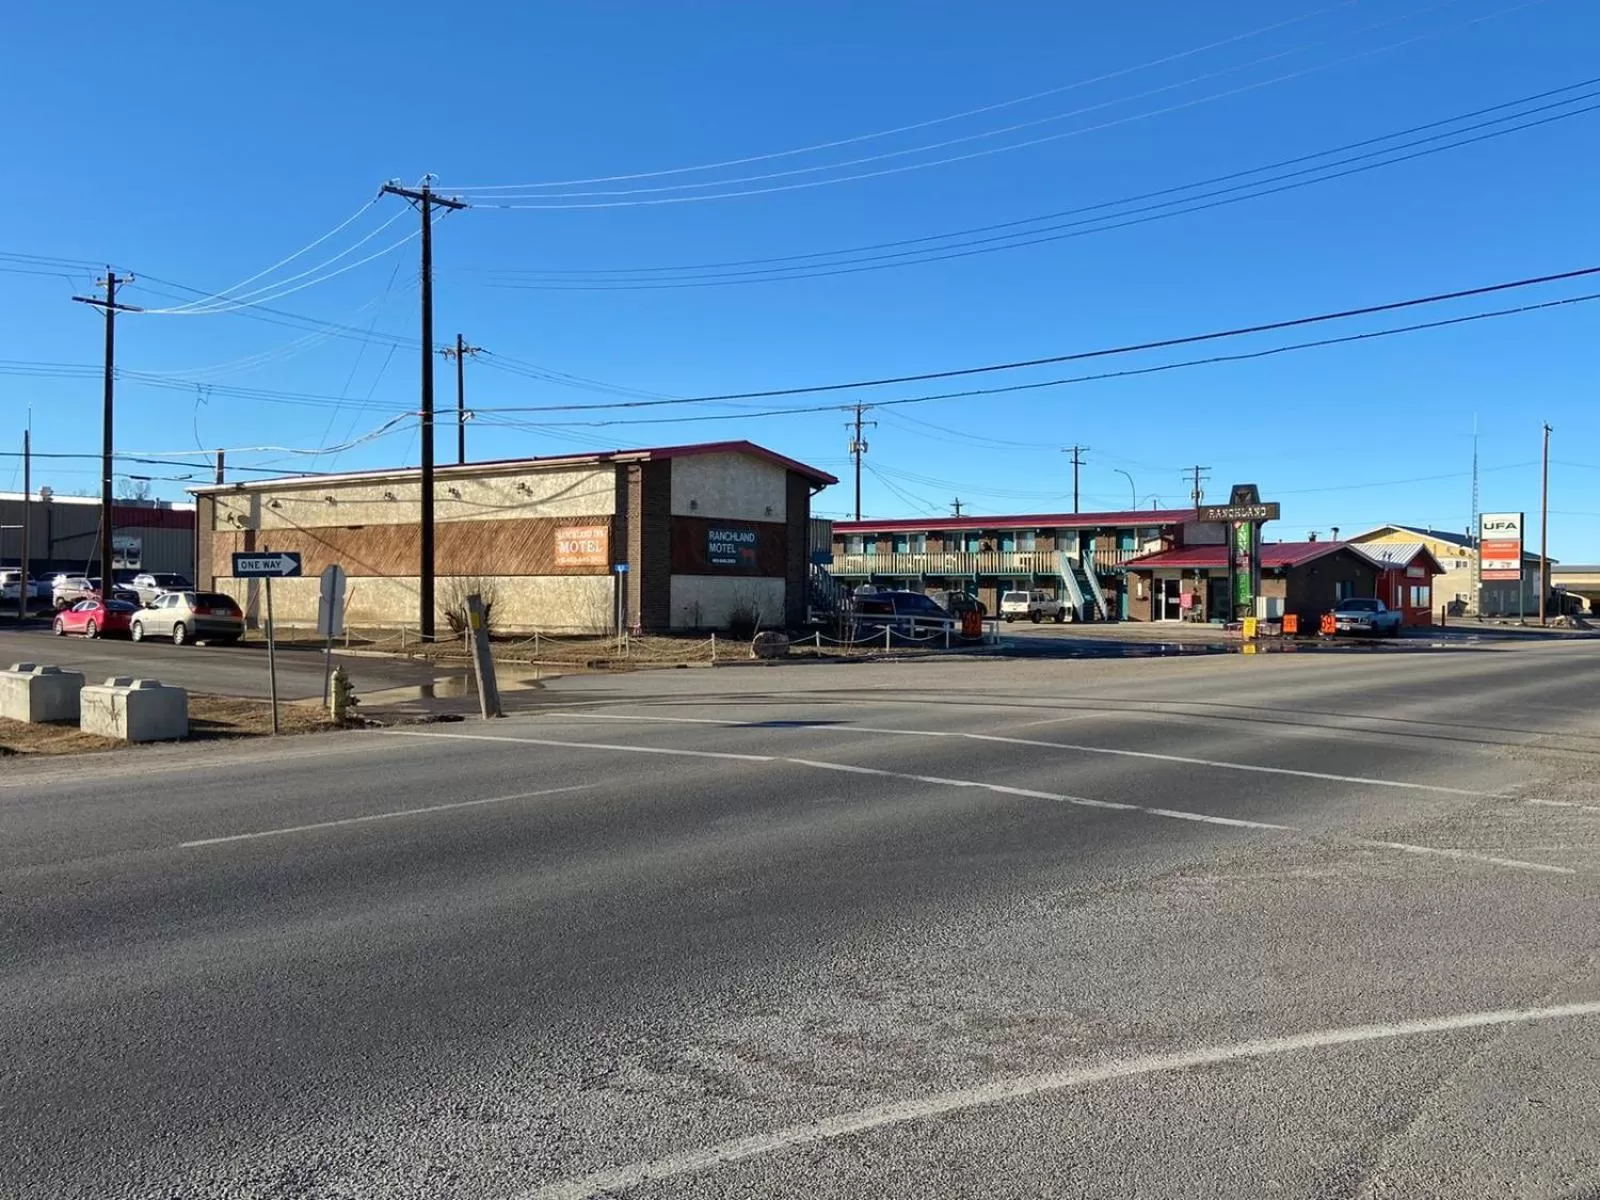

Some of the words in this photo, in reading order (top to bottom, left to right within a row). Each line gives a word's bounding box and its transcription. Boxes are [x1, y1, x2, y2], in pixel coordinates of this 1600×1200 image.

[1484, 522, 1517, 530] UFA
[709, 530, 755, 543] RANCHLAND
[557, 540, 603, 553] MOTEL
[709, 543, 736, 554] MOTEL
[241, 561, 259, 569] ONE
[263, 561, 281, 569] WAY
